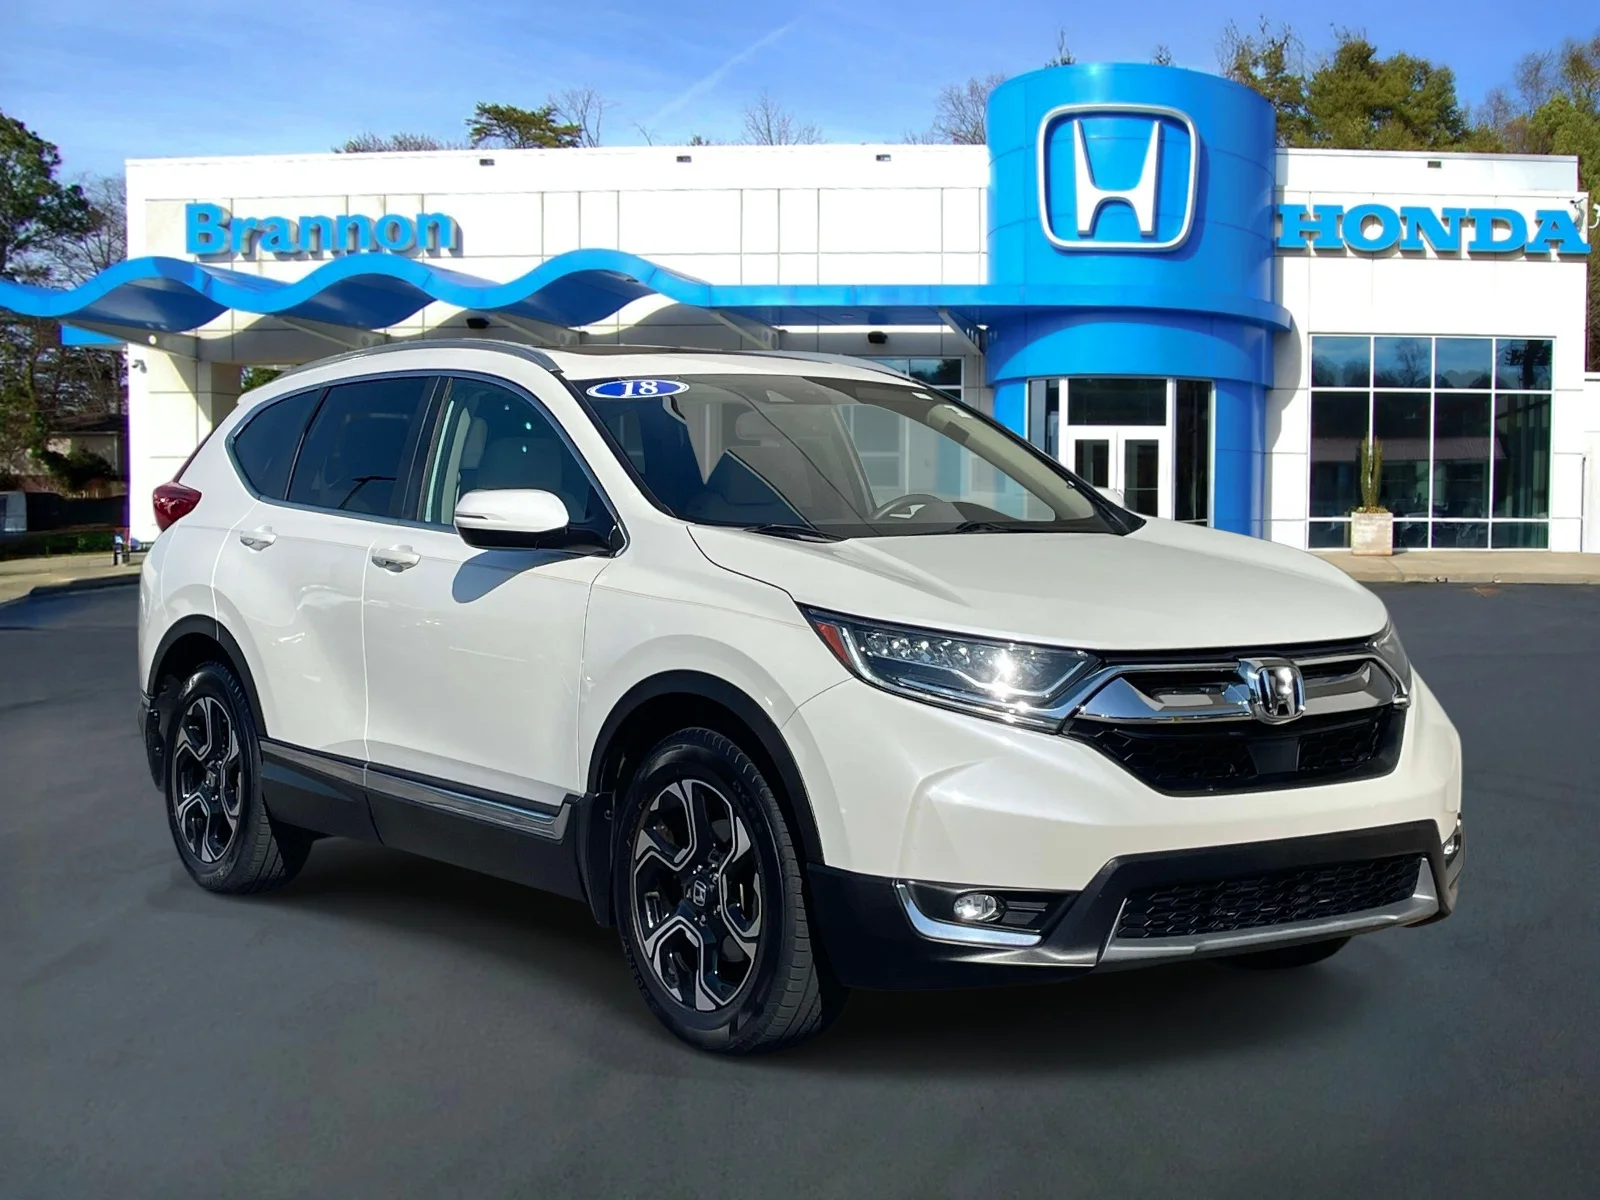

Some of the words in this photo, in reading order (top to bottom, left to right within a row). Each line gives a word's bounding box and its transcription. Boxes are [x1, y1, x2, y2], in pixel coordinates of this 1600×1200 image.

[185, 202, 458, 256] Brannon
[1276, 203, 1591, 254] HONDA
[620, 380, 659, 397] 18
